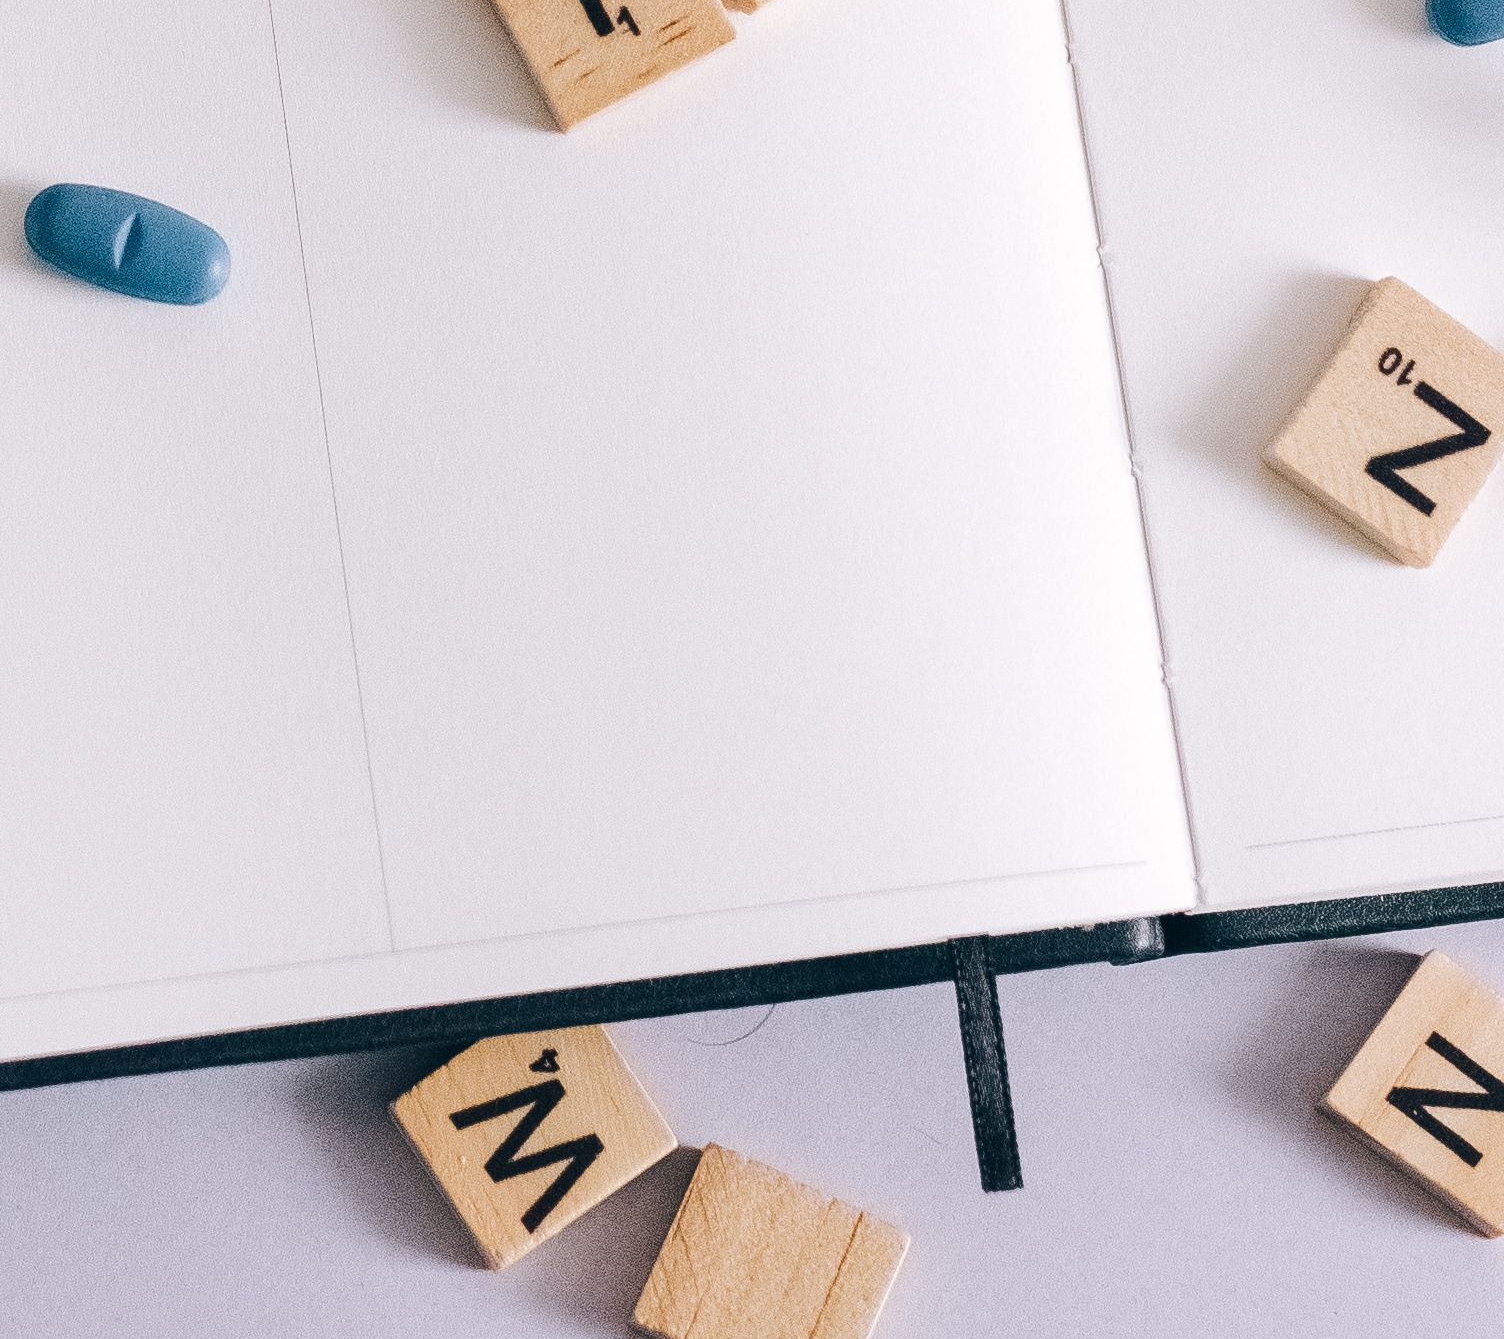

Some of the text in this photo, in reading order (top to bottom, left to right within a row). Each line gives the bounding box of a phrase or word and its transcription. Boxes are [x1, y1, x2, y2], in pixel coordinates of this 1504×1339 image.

[617, 7, 640, 36] 1
[1376, 345, 1416, 386] 10
[1365, 381, 1491, 517] Z
[529, 1048, 560, 1073] 4
